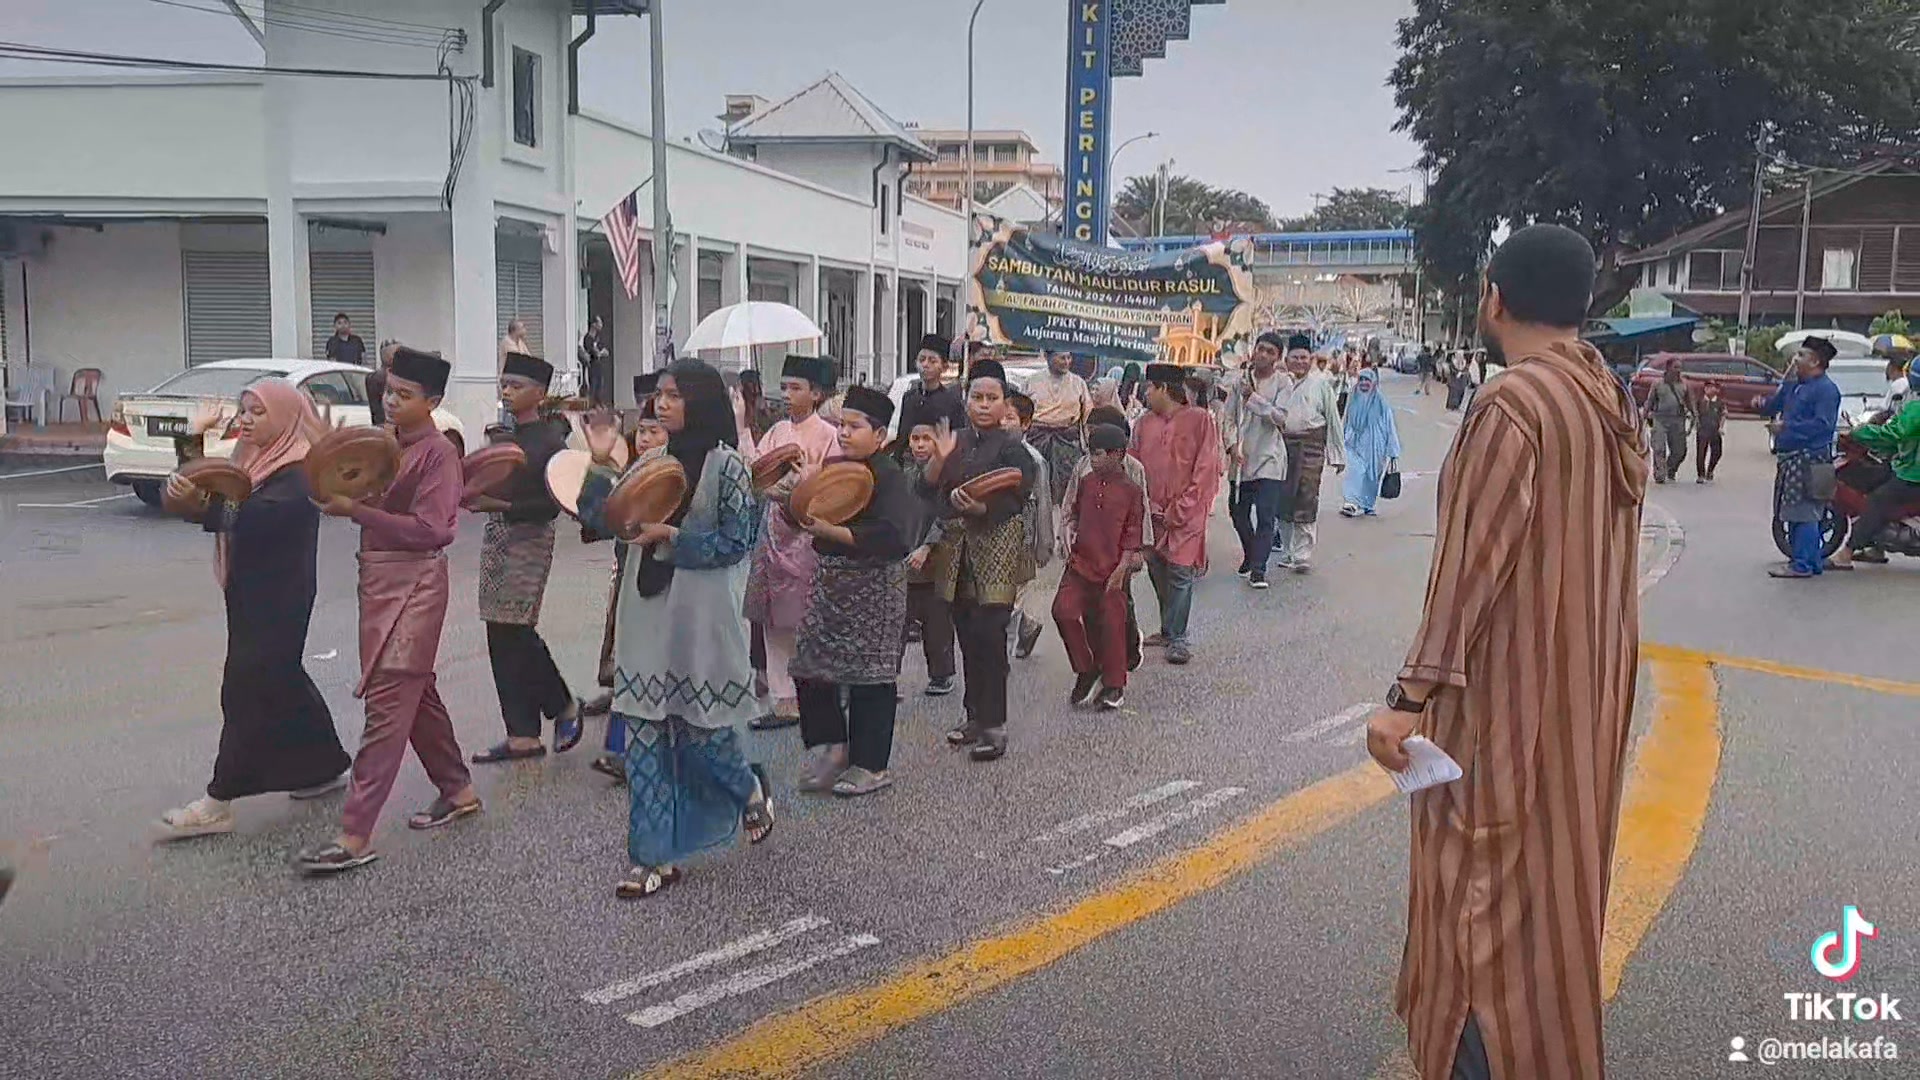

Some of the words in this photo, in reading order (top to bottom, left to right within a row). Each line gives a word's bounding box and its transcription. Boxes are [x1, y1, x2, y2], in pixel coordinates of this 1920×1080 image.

[988, 256, 1076, 284] SAMBUTAN
[1080, 273, 1161, 293] MAULIDUR
[1165, 278, 1220, 293] RASUL
[1046, 283, 1082, 298] TAHUN
[1085, 291, 1112, 303] 2024
[1046, 315, 1077, 329] JPKK
[1079, 318, 1111, 333] Bukit
[1113, 324, 1145, 339] Palah
[1101, 308, 1152, 322] MALAYSIA
[1155, 313, 1193, 324] MADANI
[1023, 325, 1069, 341] Anjuran
[1072, 332, 1111, 347] Masjid
